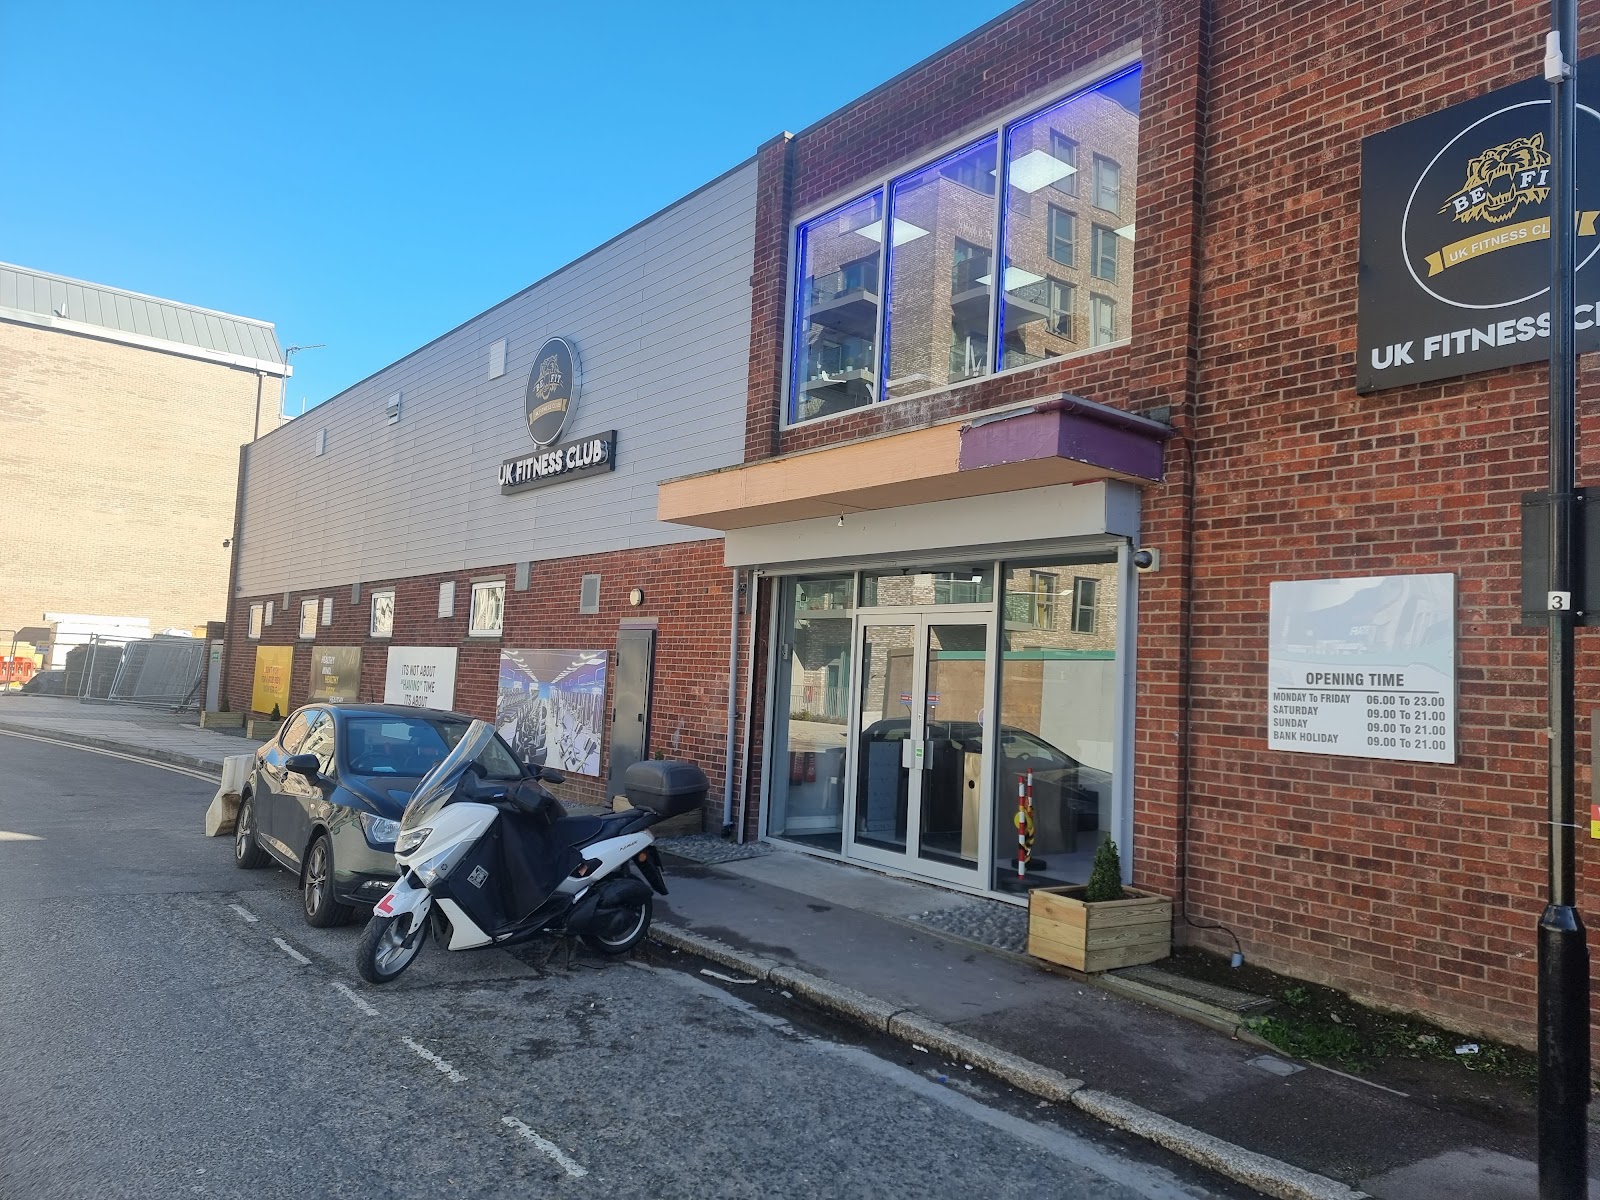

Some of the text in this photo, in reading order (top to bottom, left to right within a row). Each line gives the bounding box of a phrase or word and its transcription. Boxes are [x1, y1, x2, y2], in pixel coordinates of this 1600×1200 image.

[1452, 168, 1550, 214] BE FI
[1448, 223, 1550, 263] UK FITNESS CL
[1371, 340, 1414, 370] UK
[1424, 312, 1551, 361] FITNESS
[498, 439, 602, 486] UK FITNESS CLUB
[1552, 595, 1563, 610] 3
[420, 665, 436, 677] ABOUT
[1306, 672, 1404, 687] OPENING TIME
[423, 680, 436, 693] TIME
[412, 694, 428, 707] ABOUT
[1273, 692, 1445, 707] MONDAY To FRIDAY 06.00 To 23.00
[1273, 705, 1446, 721] SATURDAY 09.00 To 21.00
[1273, 717, 1446, 736] SUNDAY 09.00 To 21.00
[1273, 730, 1446, 751] BANK HOLIDAY 09.00 To 21.00
[377, 894, 395, 914] L
